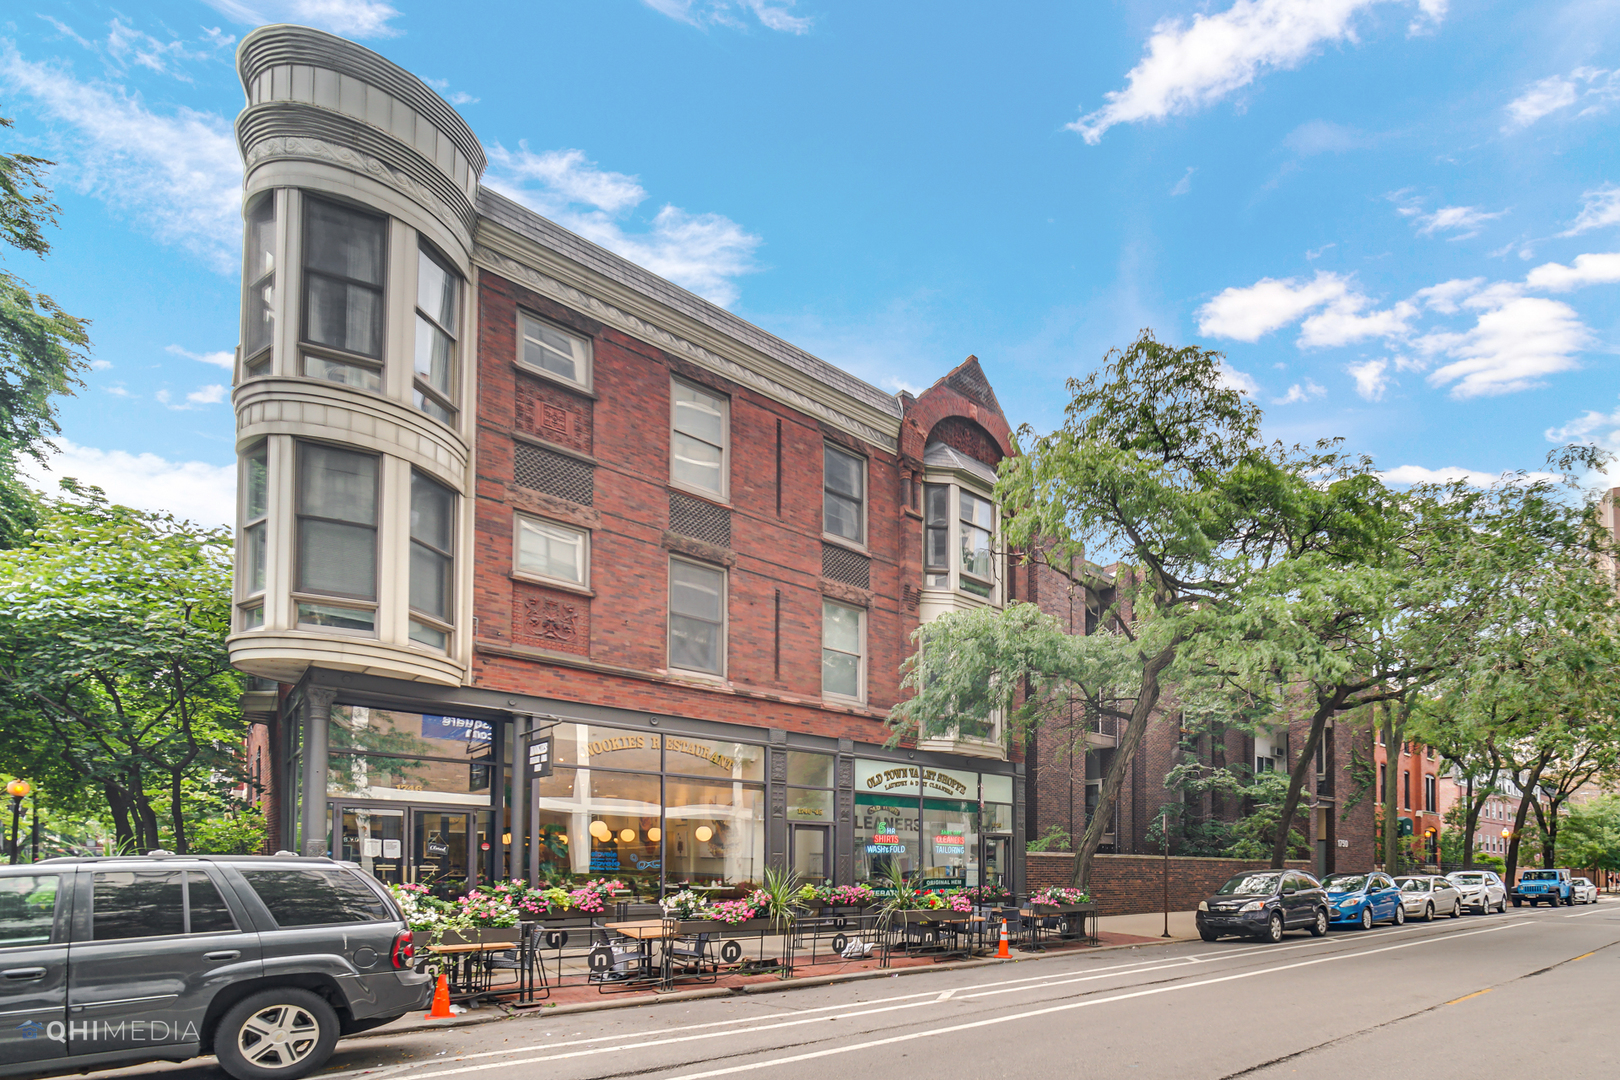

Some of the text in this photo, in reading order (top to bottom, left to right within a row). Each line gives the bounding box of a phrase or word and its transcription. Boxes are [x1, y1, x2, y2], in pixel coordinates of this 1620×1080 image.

[583, 736, 733, 771] NOOKIES RESTAURANT
[866, 768, 967, 795] OLD TOWN VALET SHOPPE
[884, 780, 907, 790] LAUNDRY
[929, 782, 953, 796] CLEANERS
[878, 821, 887, 834] 5
[874, 834, 899, 844] SHIRTS
[935, 835, 965, 845] CLEANERS
[889, 845, 906, 853] FOLD
[935, 845, 965, 855] TAILORING
[837, 918, 844, 926] n
[1061, 922, 1067, 930] n
[925, 932, 933, 942] n
[836, 938, 844, 949] n
[726, 946, 737, 957] n
[594, 953, 607, 967] n
